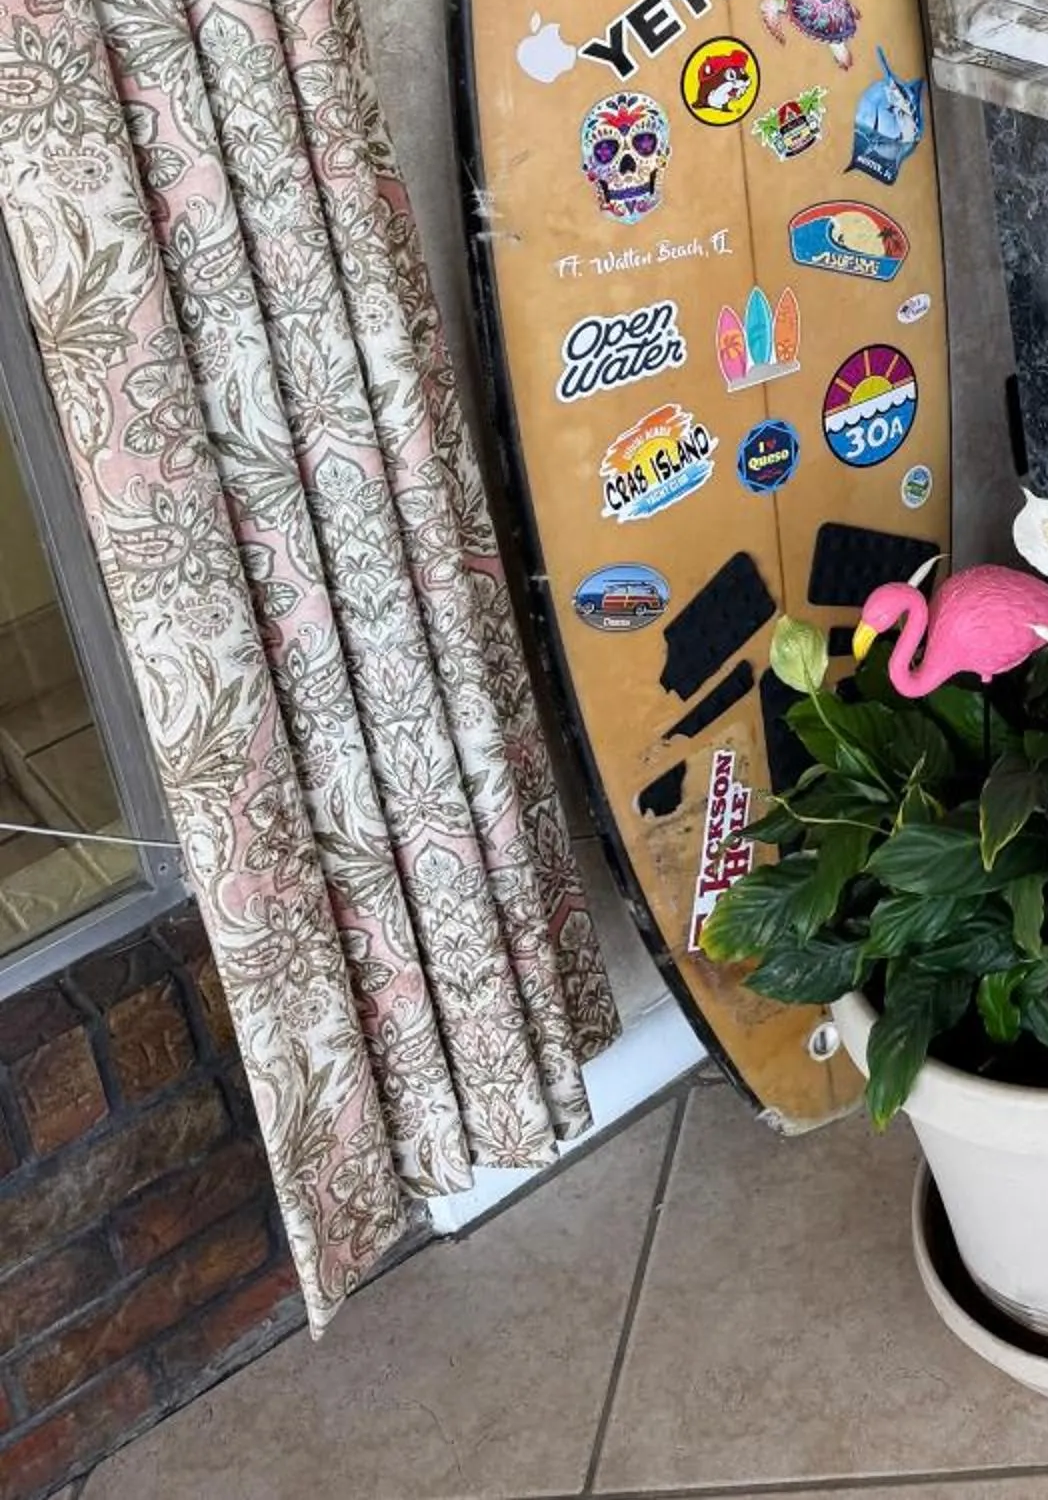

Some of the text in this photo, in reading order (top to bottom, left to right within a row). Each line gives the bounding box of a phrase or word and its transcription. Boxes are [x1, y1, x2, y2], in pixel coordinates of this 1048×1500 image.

[590, 248, 652, 275] Walton
[656, 238, 709, 263] Beach,
[567, 305, 673, 360] Open
[759, 441, 765, 453] I
[845, 416, 903, 458] 30A
[606, 464, 649, 510] CRAB
[649, 426, 710, 484] ISLAND
[748, 449, 789, 470] Queso
[700, 754, 733, 898] JACKSON
